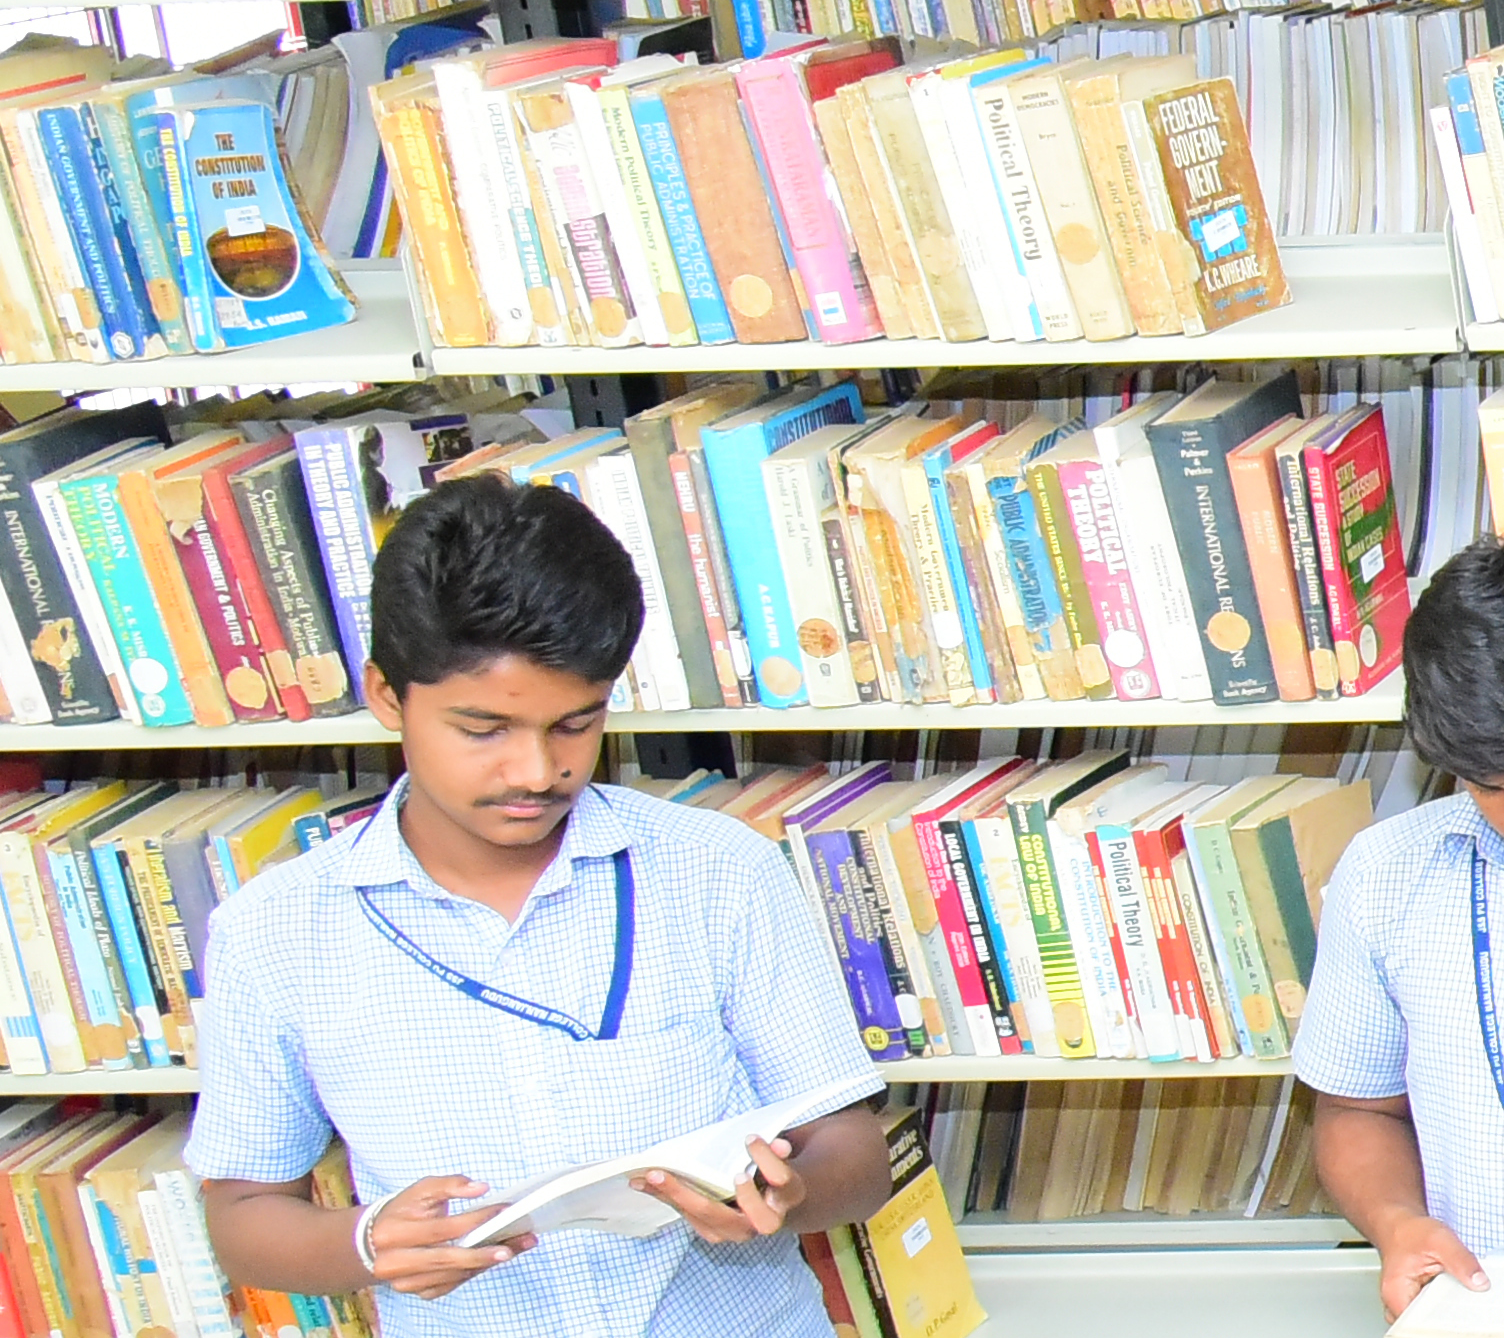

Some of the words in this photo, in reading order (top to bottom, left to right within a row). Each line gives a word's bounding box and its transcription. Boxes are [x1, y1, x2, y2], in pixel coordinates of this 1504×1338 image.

[1159, 92, 1219, 135] FEDERAL
[195, 154, 266, 177] CONSTITUTION
[215, 134, 235, 151] THE
[1169, 125, 1227, 169] GOVERN-
[212, 181, 226, 200] OF
[228, 178, 257, 197] INDIA
[611, 106, 632, 155] Modern
[625, 154, 647, 209] Political
[638, 205, 659, 252] Theory
[984, 98, 1023, 178] Political
[1012, 186, 1042, 261] Theory
[1107, 180, 1121, 204] and
[1116, 144, 1136, 194] Political
[1129, 196, 1149, 246] Science
[1184, 161, 1223, 202] MENT
[640, 124, 664, 175] PUBLIC
[656, 177, 700, 300] ADMINISTRATION
[326, 443, 349, 497] PUBLIC
[674, 471, 696, 513] NEHRU
[1308, 467, 1324, 499] STATE
[1335, 460, 1357, 489] STATE
[94, 483, 129, 560] MODERN
[337, 497, 372, 597] ADMINISTRATION
[688, 533, 702, 555] the
[1067, 484, 1105, 563] THEORY
[1085, 470, 1125, 575] POLITICAL
[1196, 485, 1231, 594] INTERNATIONAL
[1286, 460, 1310, 536] International
[1301, 537, 1320, 605] Relations
[1313, 501, 1335, 571] SUCCESSION
[7, 510, 51, 617] INTERNATIONAL
[693, 558, 720, 617] humanist
[1031, 833, 1062, 932] CONSTITUTIONAL
[1108, 841, 1138, 900] Political
[1475, 863, 1485, 901] COLLEGE
[163, 900, 180, 925] and
[816, 848, 833, 898] NATIONAL
[828, 898, 850, 960] MOVEMENT
[837, 864, 864, 940] DEVELOPMENT
[846, 856, 876, 945] CONSTITUTIONAL
[860, 833, 889, 911] International
[882, 913, 906, 969] Relations
[1121, 901, 1144, 949] Theory
[1476, 902, 1485, 916] PU
[1476, 917, 1487, 933] JSS
[171, 926, 193, 971] Marxism
[1486, 1013, 1499, 1056] COLLEGE
